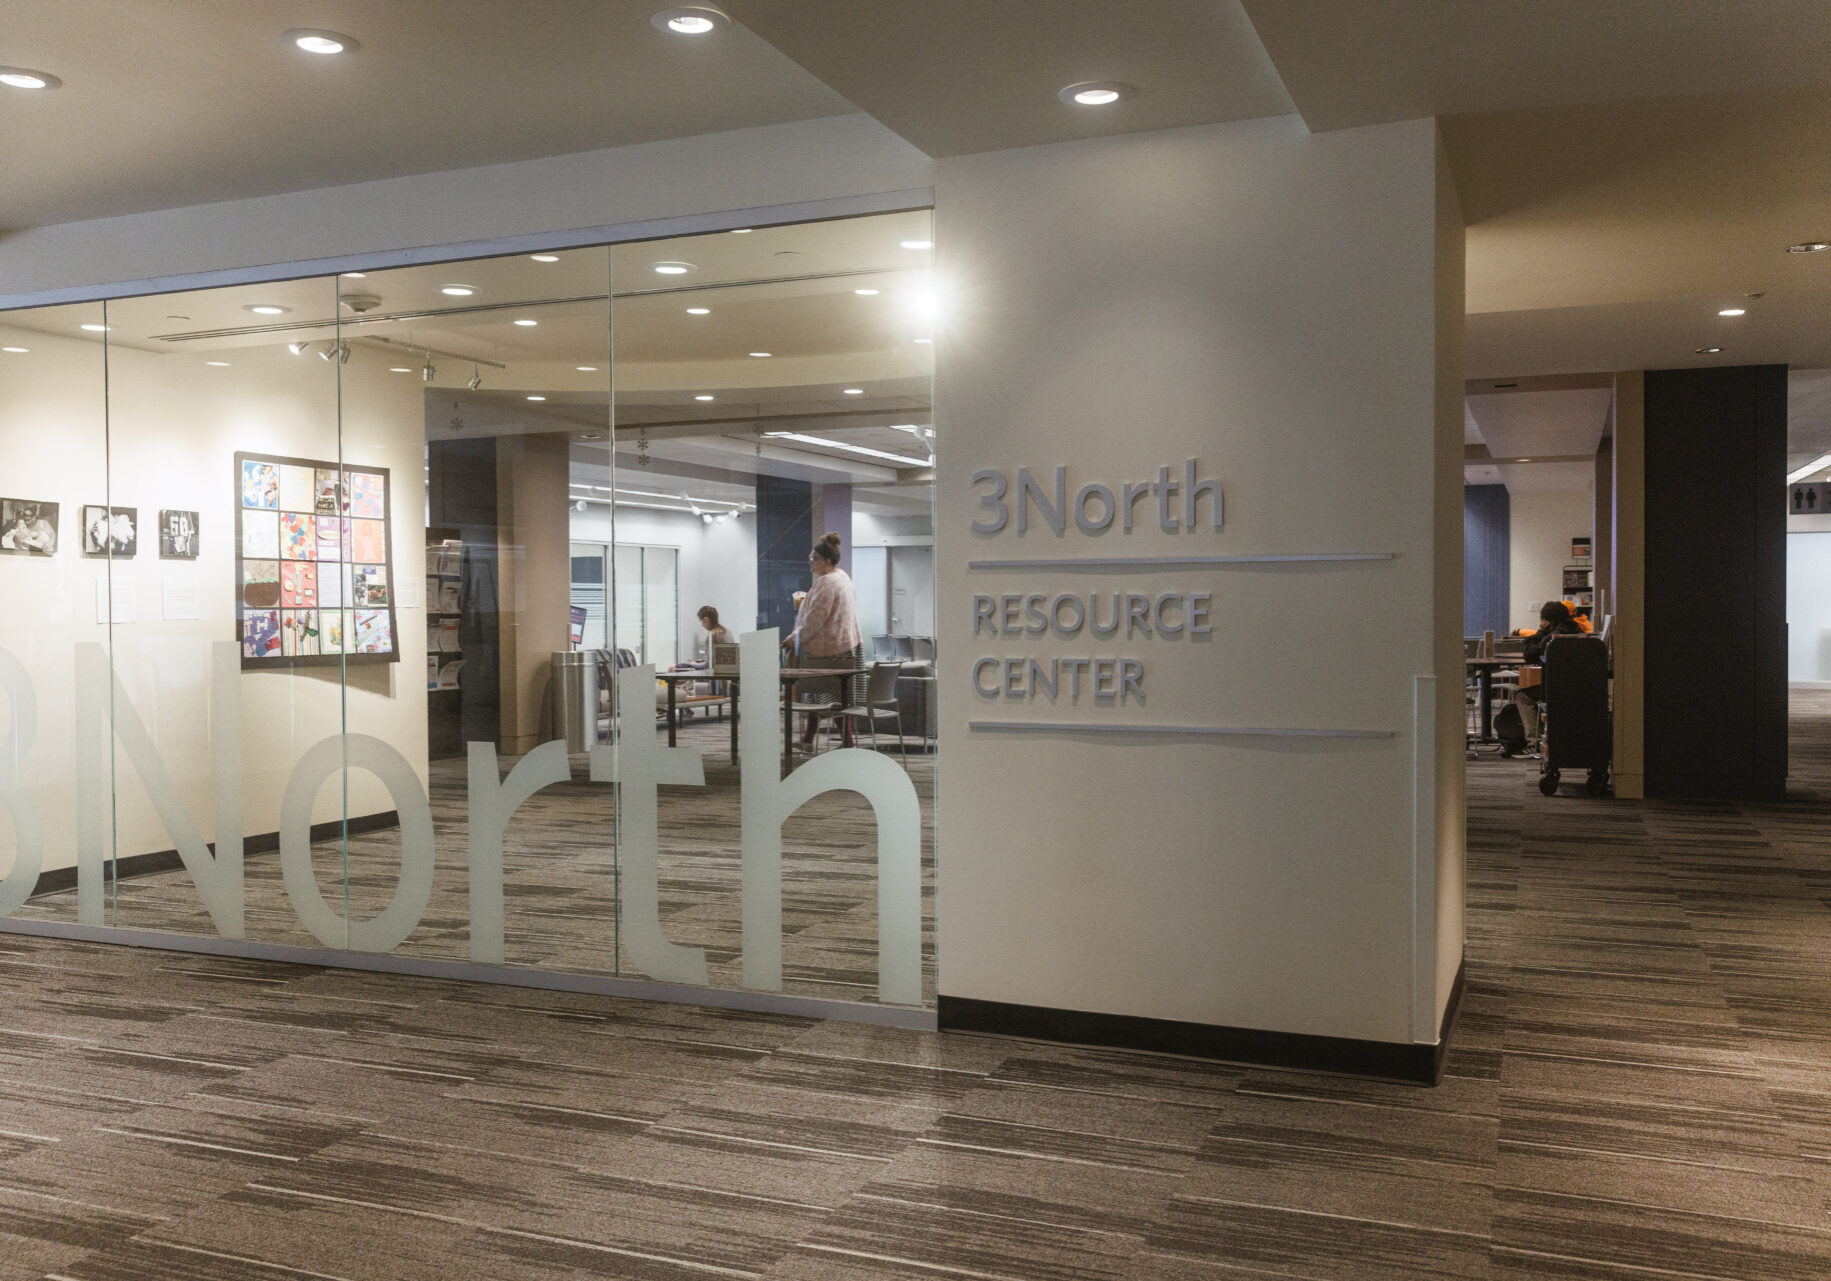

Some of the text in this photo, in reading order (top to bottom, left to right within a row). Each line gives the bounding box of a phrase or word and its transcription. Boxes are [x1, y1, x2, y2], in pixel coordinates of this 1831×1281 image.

[971, 458, 1224, 533] 3North
[973, 594, 1212, 634] RESOURCE
[972, 658, 1146, 699] CENTER
